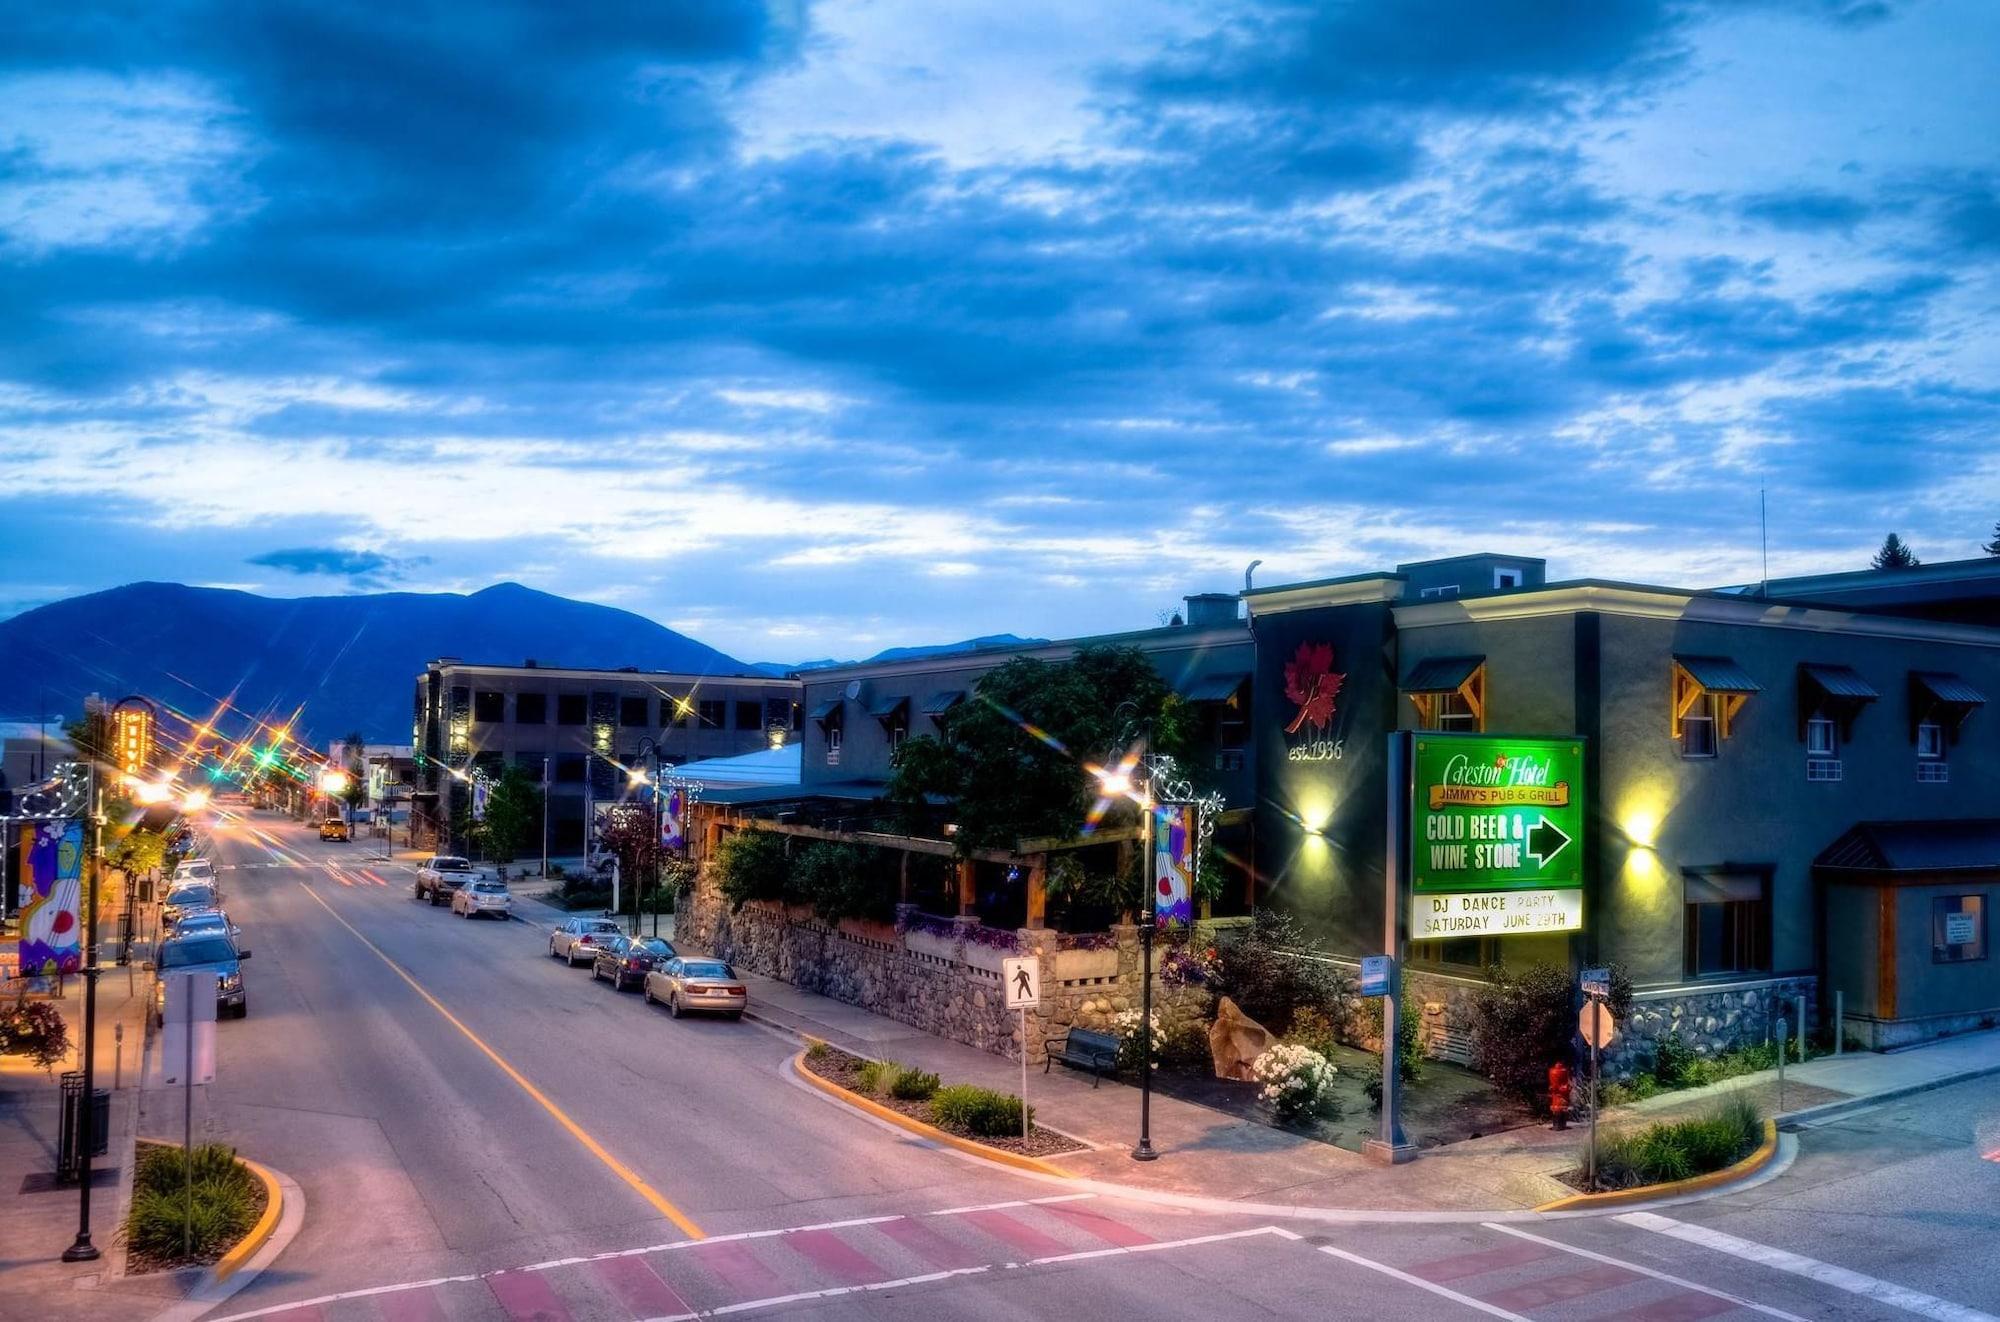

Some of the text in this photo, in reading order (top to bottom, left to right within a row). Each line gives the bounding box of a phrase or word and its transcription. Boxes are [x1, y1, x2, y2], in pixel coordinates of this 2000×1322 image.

[1443, 753, 1551, 790] Creston Hotel
[1440, 787, 1561, 802] JIMMY'S PUB & GRILL
[1426, 813, 1524, 840] COLD BEER &
[1430, 843, 1521, 870] WINE STORE
[1433, 894, 1555, 912] DJ DANCE PARTY
[1424, 916, 1489, 933] SATURDAY
[1503, 913, 1531, 928] JUNE
